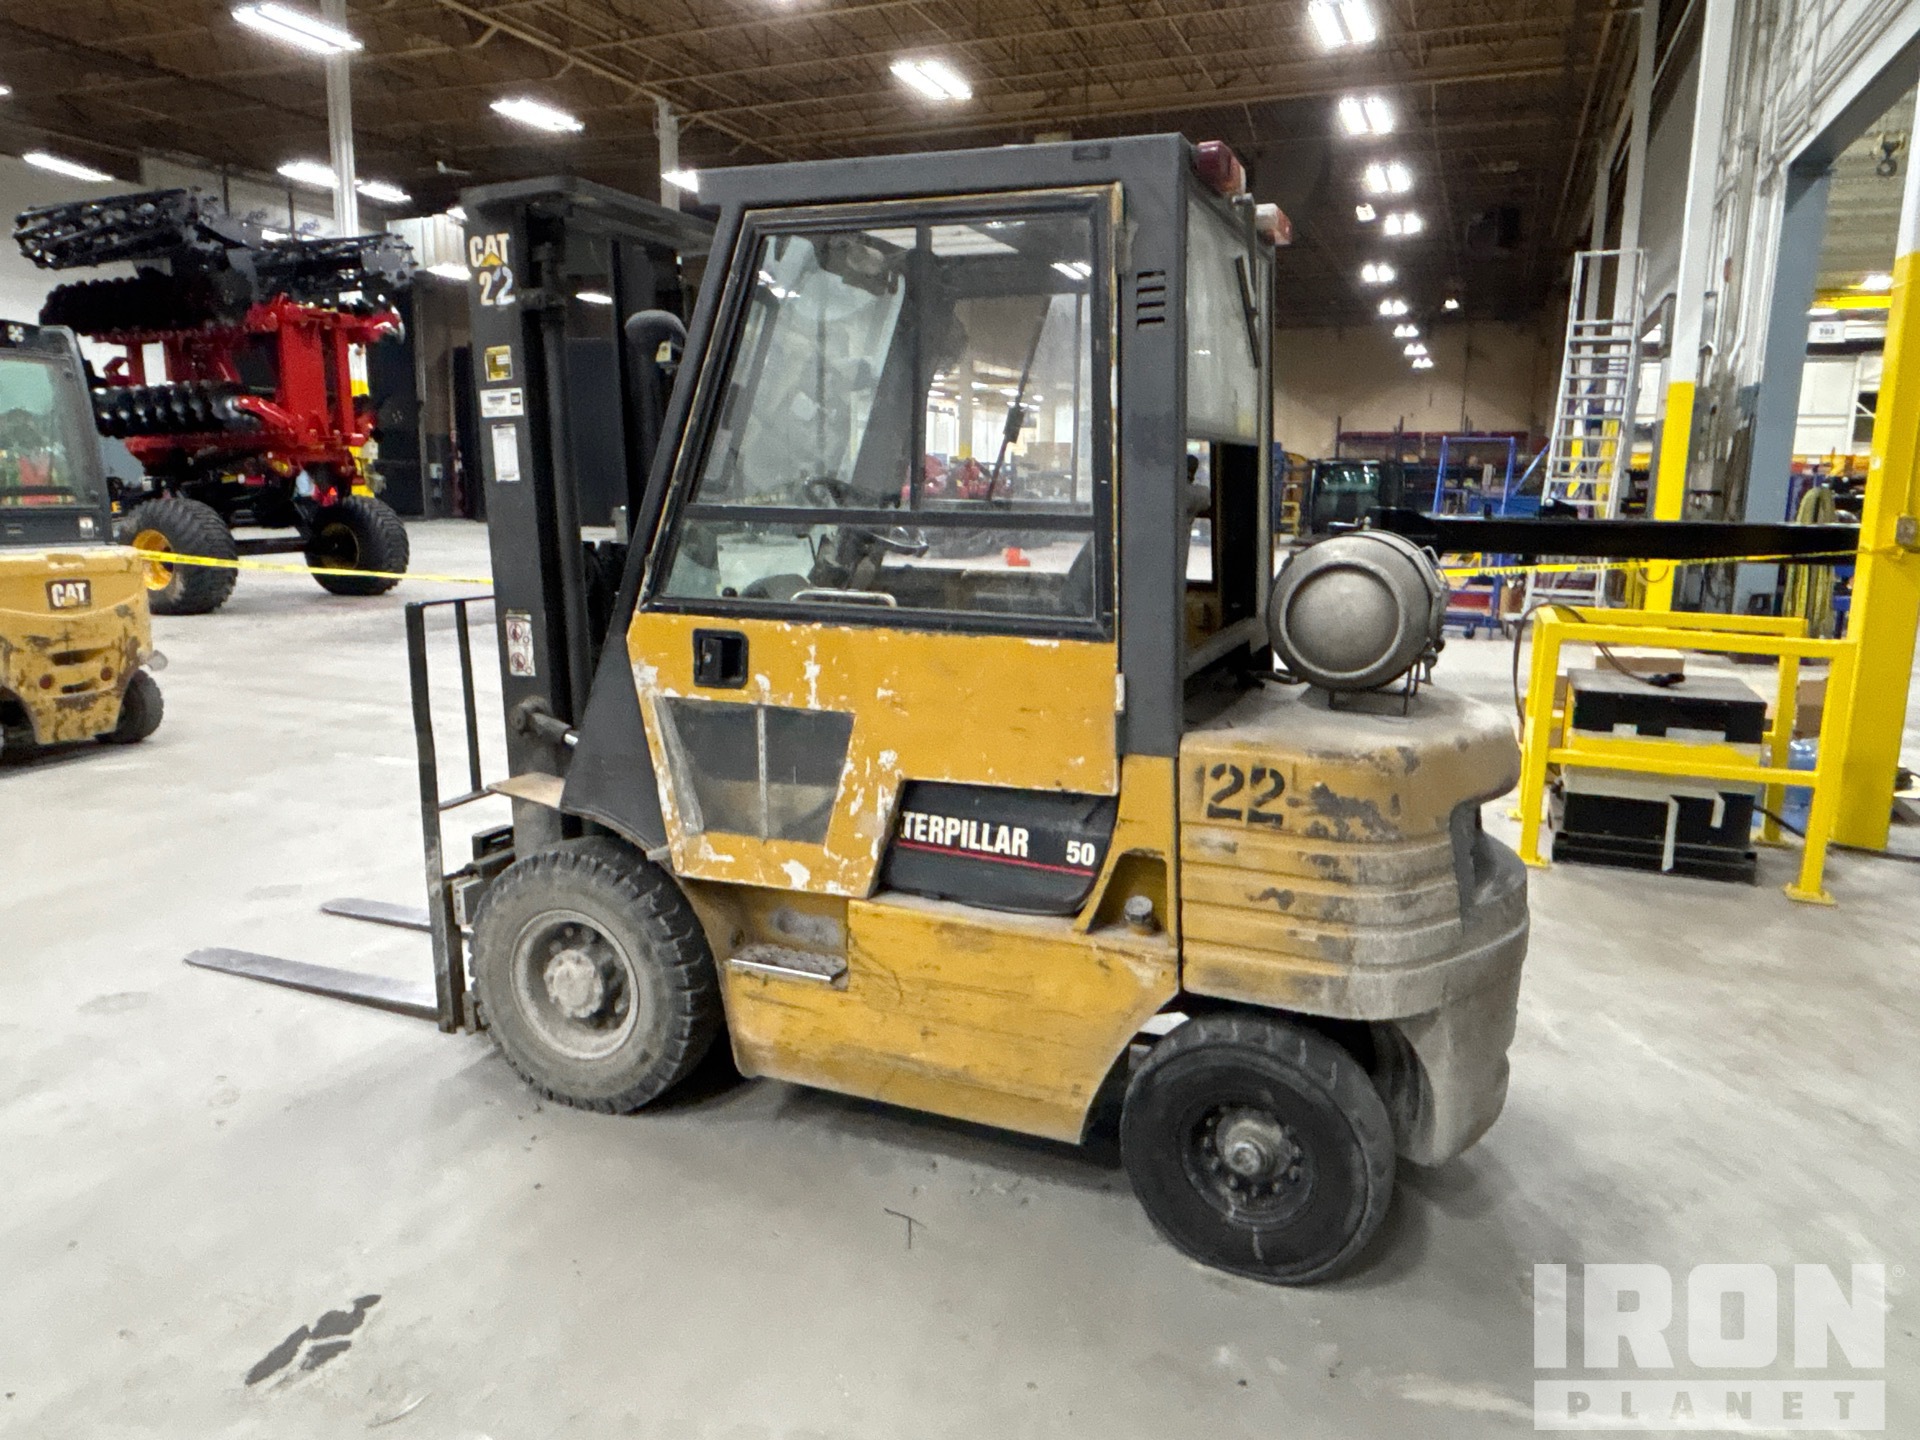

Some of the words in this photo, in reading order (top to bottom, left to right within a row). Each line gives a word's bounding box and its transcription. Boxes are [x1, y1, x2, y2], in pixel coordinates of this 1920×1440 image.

[470, 232, 510, 268] CAT
[479, 266, 516, 306] 22
[51, 582, 86, 607] CAT
[1207, 763, 1285, 826] 22
[901, 811, 1029, 858] TERPILLAR
[1066, 840, 1095, 866] 50
